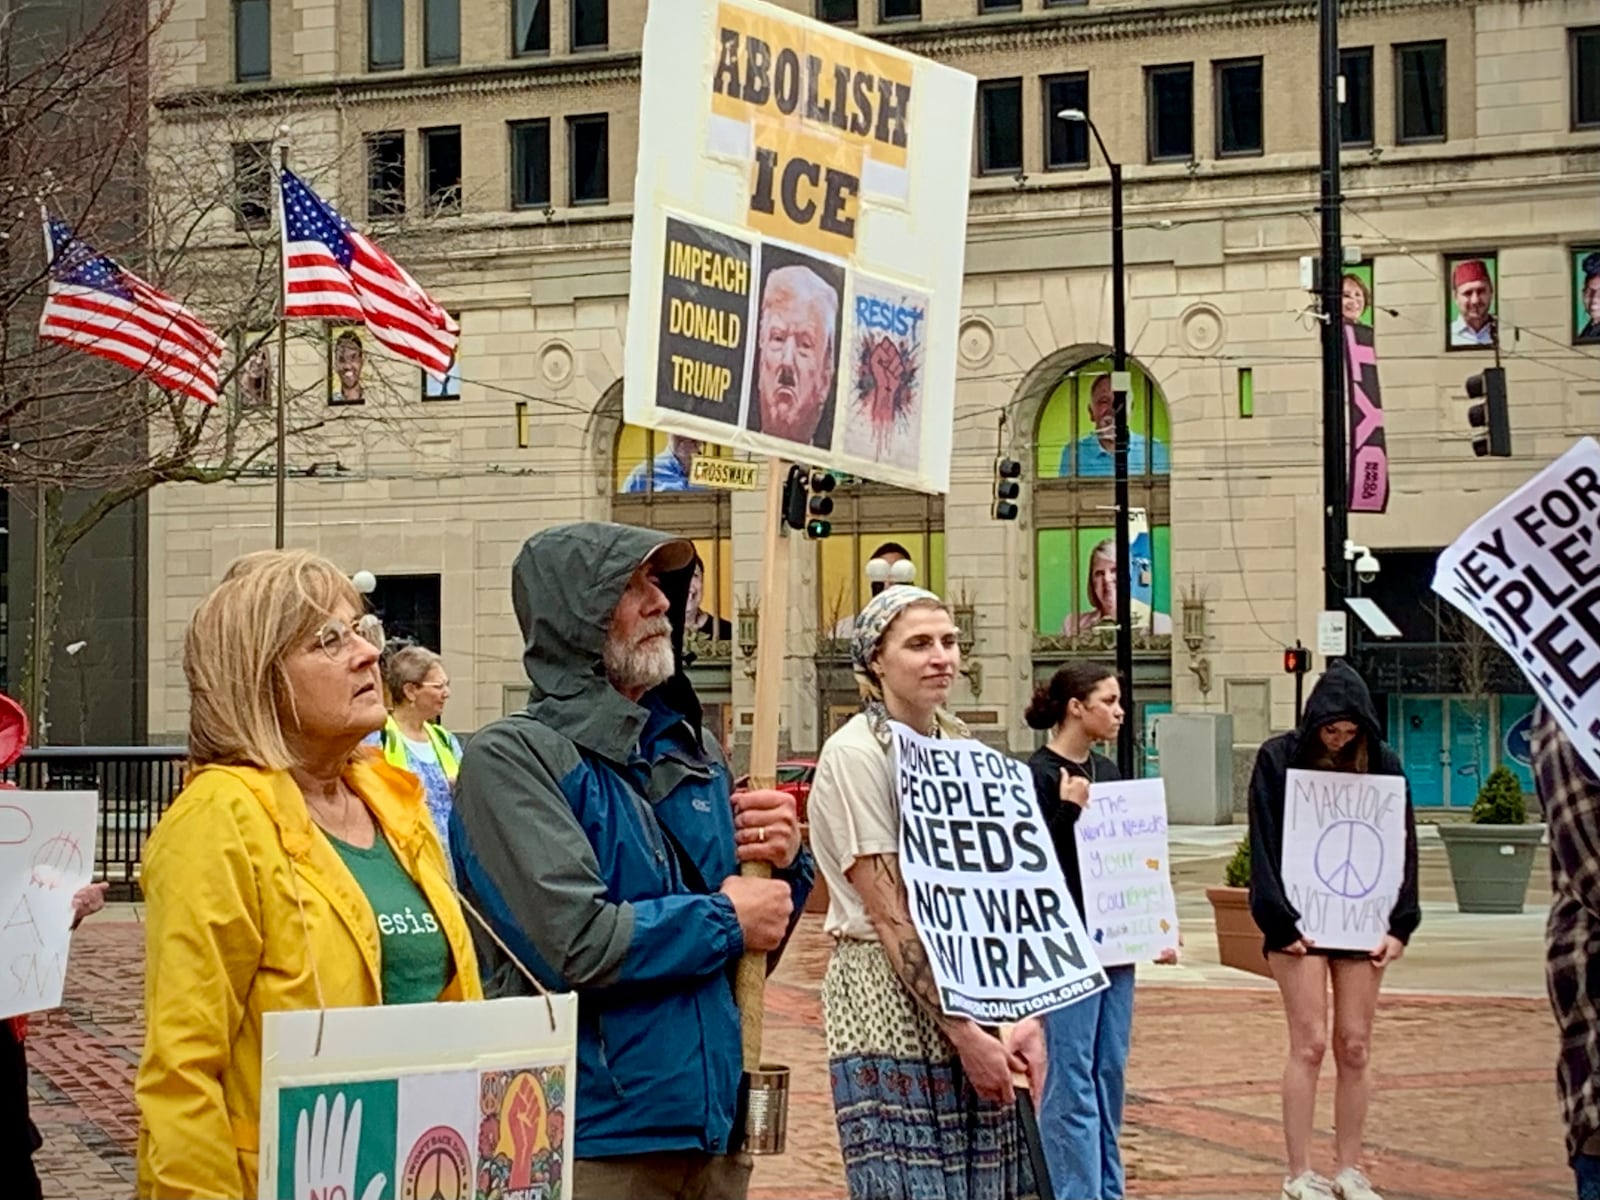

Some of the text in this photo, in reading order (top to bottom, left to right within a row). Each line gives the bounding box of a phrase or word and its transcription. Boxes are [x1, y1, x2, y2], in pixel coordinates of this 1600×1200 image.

[713, 27, 911, 149] ABOLISH
[751, 146, 860, 239] ICE
[668, 240, 747, 296] IMPEACH
[669, 297, 741, 349] DONALD
[855, 295, 924, 342] RESIST
[671, 355, 732, 403] TRUMP
[694, 462, 755, 485] CROSSWALK
[899, 733, 1023, 782] MONEY FOR
[901, 768, 1033, 819] PEOPLE'S
[902, 812, 1048, 873] NEEDS
[913, 878, 1070, 934] NOT WAR
[971, 931, 1088, 989] IRAN
[948, 977, 1096, 1018] ACOALITION.ORG
